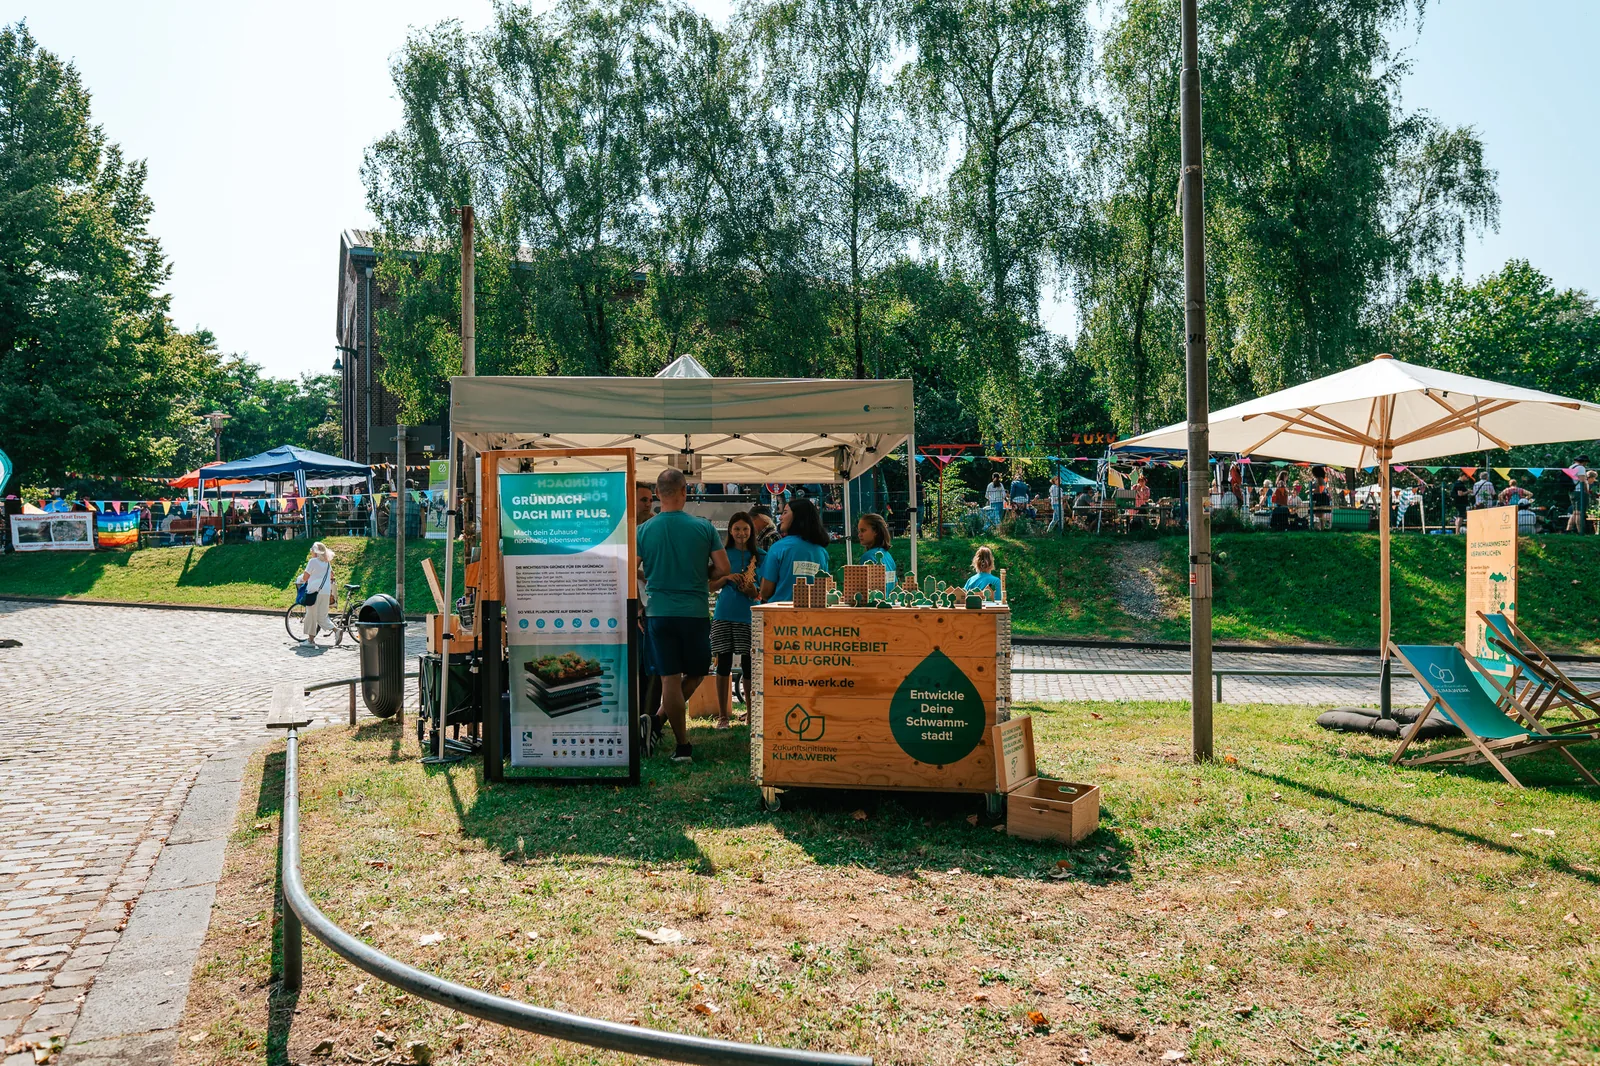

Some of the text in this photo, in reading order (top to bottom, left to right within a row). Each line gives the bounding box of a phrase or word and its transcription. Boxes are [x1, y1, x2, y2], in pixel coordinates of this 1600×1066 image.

[512, 493, 586, 505] GRÜNDACH-
[513, 509, 610, 519] DACH MIT PLUS.
[774, 626, 860, 637] WIR MACHEN
[774, 640, 888, 652] DAS RUHRGEBIET
[774, 654, 854, 666] BLAU-GRÜN.
[773, 676, 854, 688] klima-werk.de
[910, 690, 964, 700] Entwickle
[921, 703, 954, 713] Deine
[906, 717, 968, 727] Schwamm-
[921, 731, 952, 740] stadt!
[773, 744, 837, 752] Zukunftsinitiative
[772, 753, 836, 762] KLIMA.WERK
